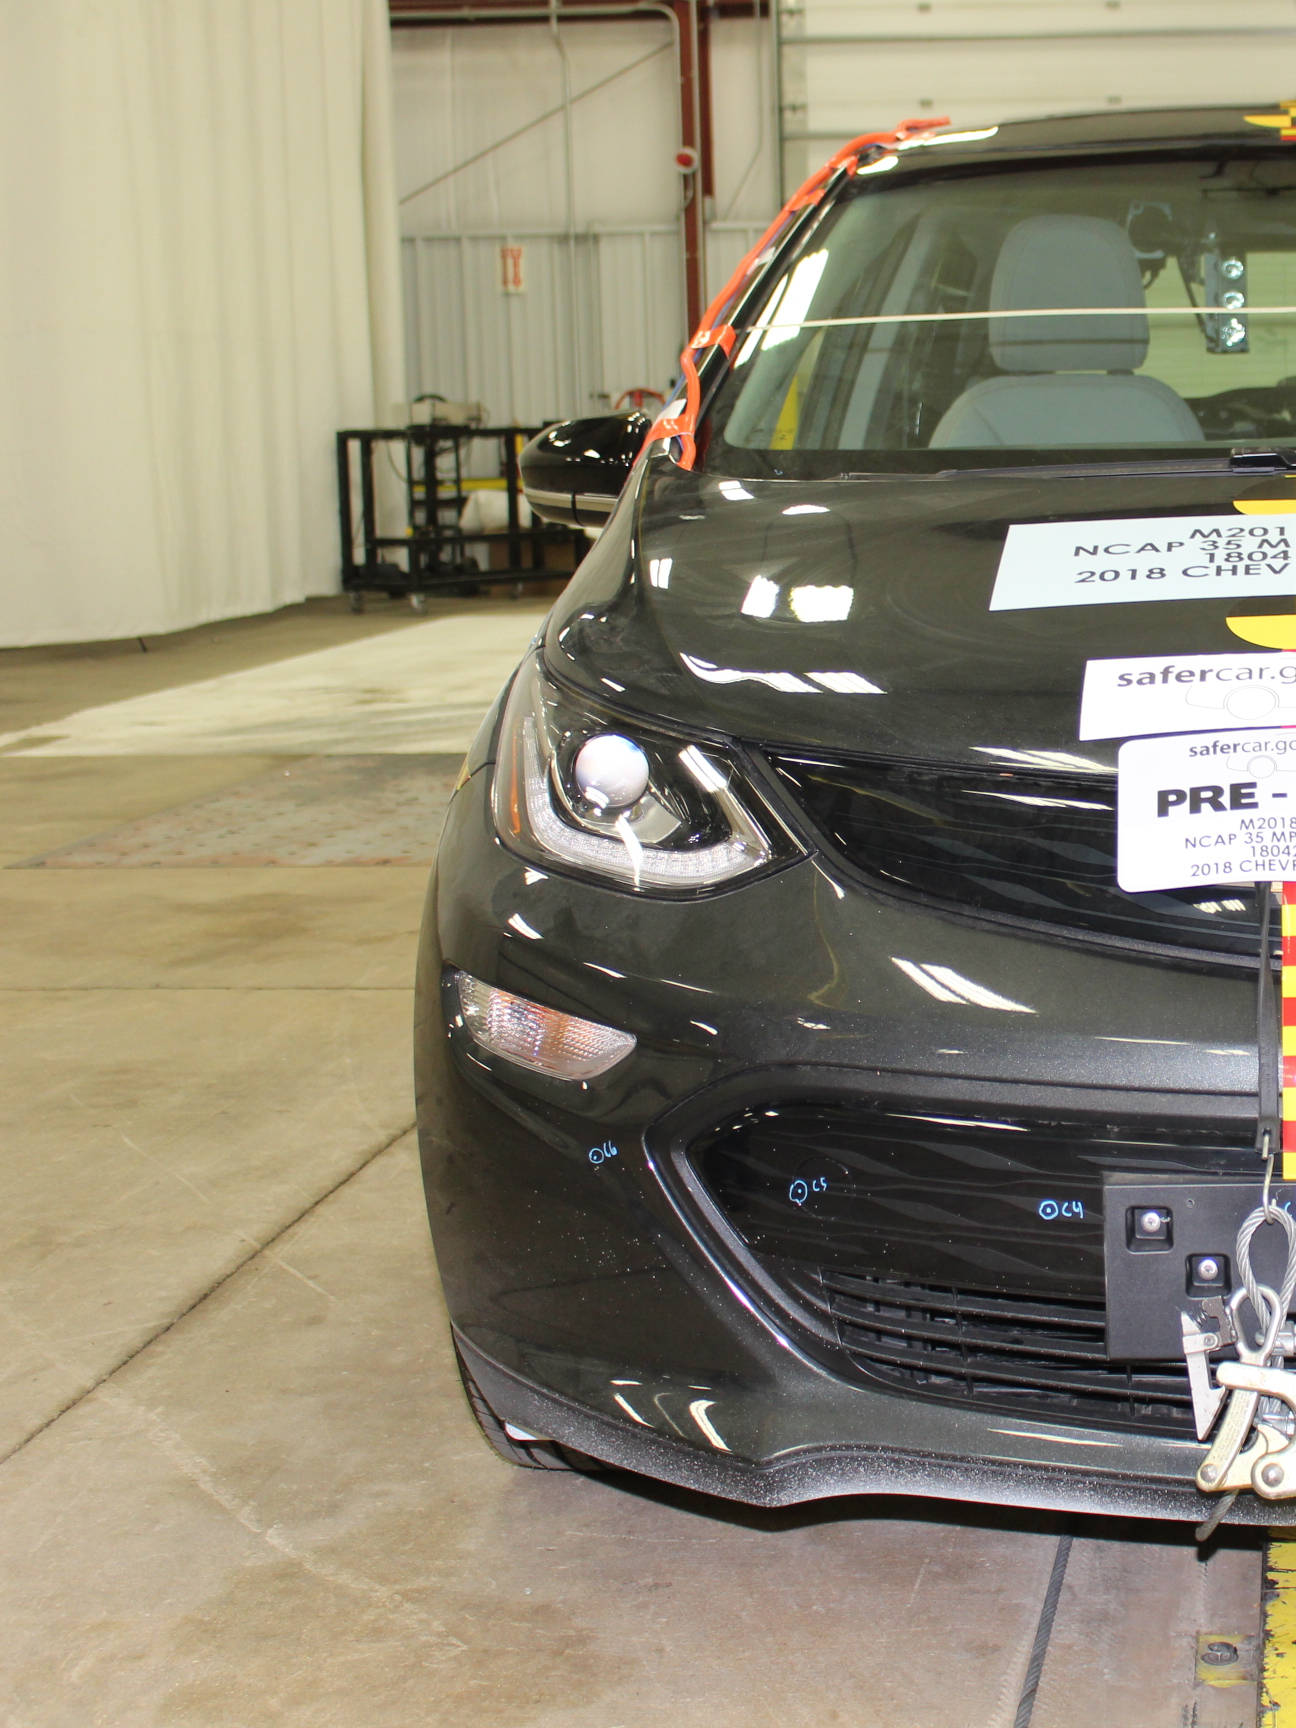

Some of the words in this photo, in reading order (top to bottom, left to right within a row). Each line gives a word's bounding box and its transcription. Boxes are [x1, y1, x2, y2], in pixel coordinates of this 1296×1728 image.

[1074, 542, 1185, 556] NCAP
[1199, 540, 1242, 550] 35
[1074, 568, 1166, 583] 2018
[1157, 782, 1259, 818] PRE
[1185, 833, 1237, 849] NCAP
[1245, 832, 1264, 844] 35
[1191, 862, 1232, 877] 2018
